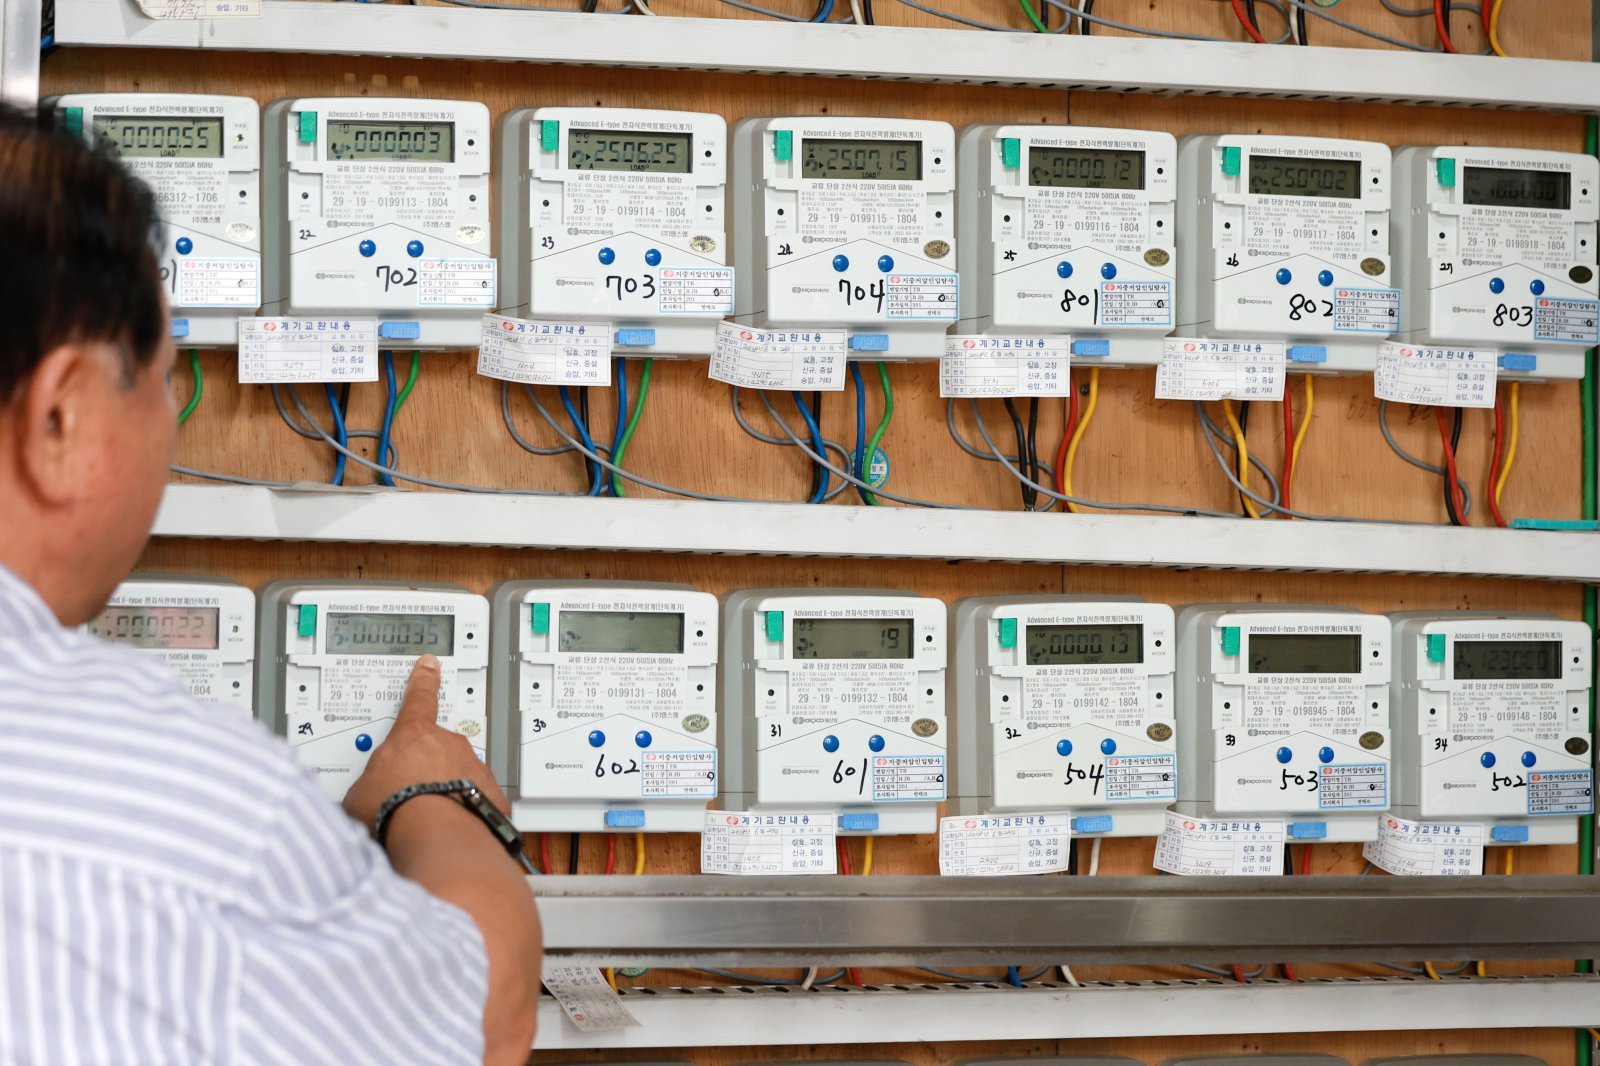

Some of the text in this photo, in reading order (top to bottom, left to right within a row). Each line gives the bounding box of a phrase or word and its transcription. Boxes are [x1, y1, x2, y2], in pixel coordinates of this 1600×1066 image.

[601, 121, 620, 129] E-type
[1059, 139, 1077, 147] E-type
[196, 193, 217, 202] 1706
[542, 237, 554, 250] 23
[1004, 250, 1017, 261] 25
[376, 265, 417, 292] 702
[606, 275, 655, 300] 703
[839, 279, 885, 313] 704
[1060, 289, 1098, 325] 801
[1289, 294, 1333, 320] 802
[1493, 303, 1533, 327] 803
[881, 628, 900, 649] 19
[771, 724, 781, 737] 31
[1006, 728, 1021, 739] 32
[1435, 738, 1448, 752] 34
[595, 754, 640, 777] 602
[833, 758, 867, 795] 601
[1064, 763, 1104, 795] 504
[1280, 769, 1318, 791] 503
[1492, 772, 1527, 791] 502
